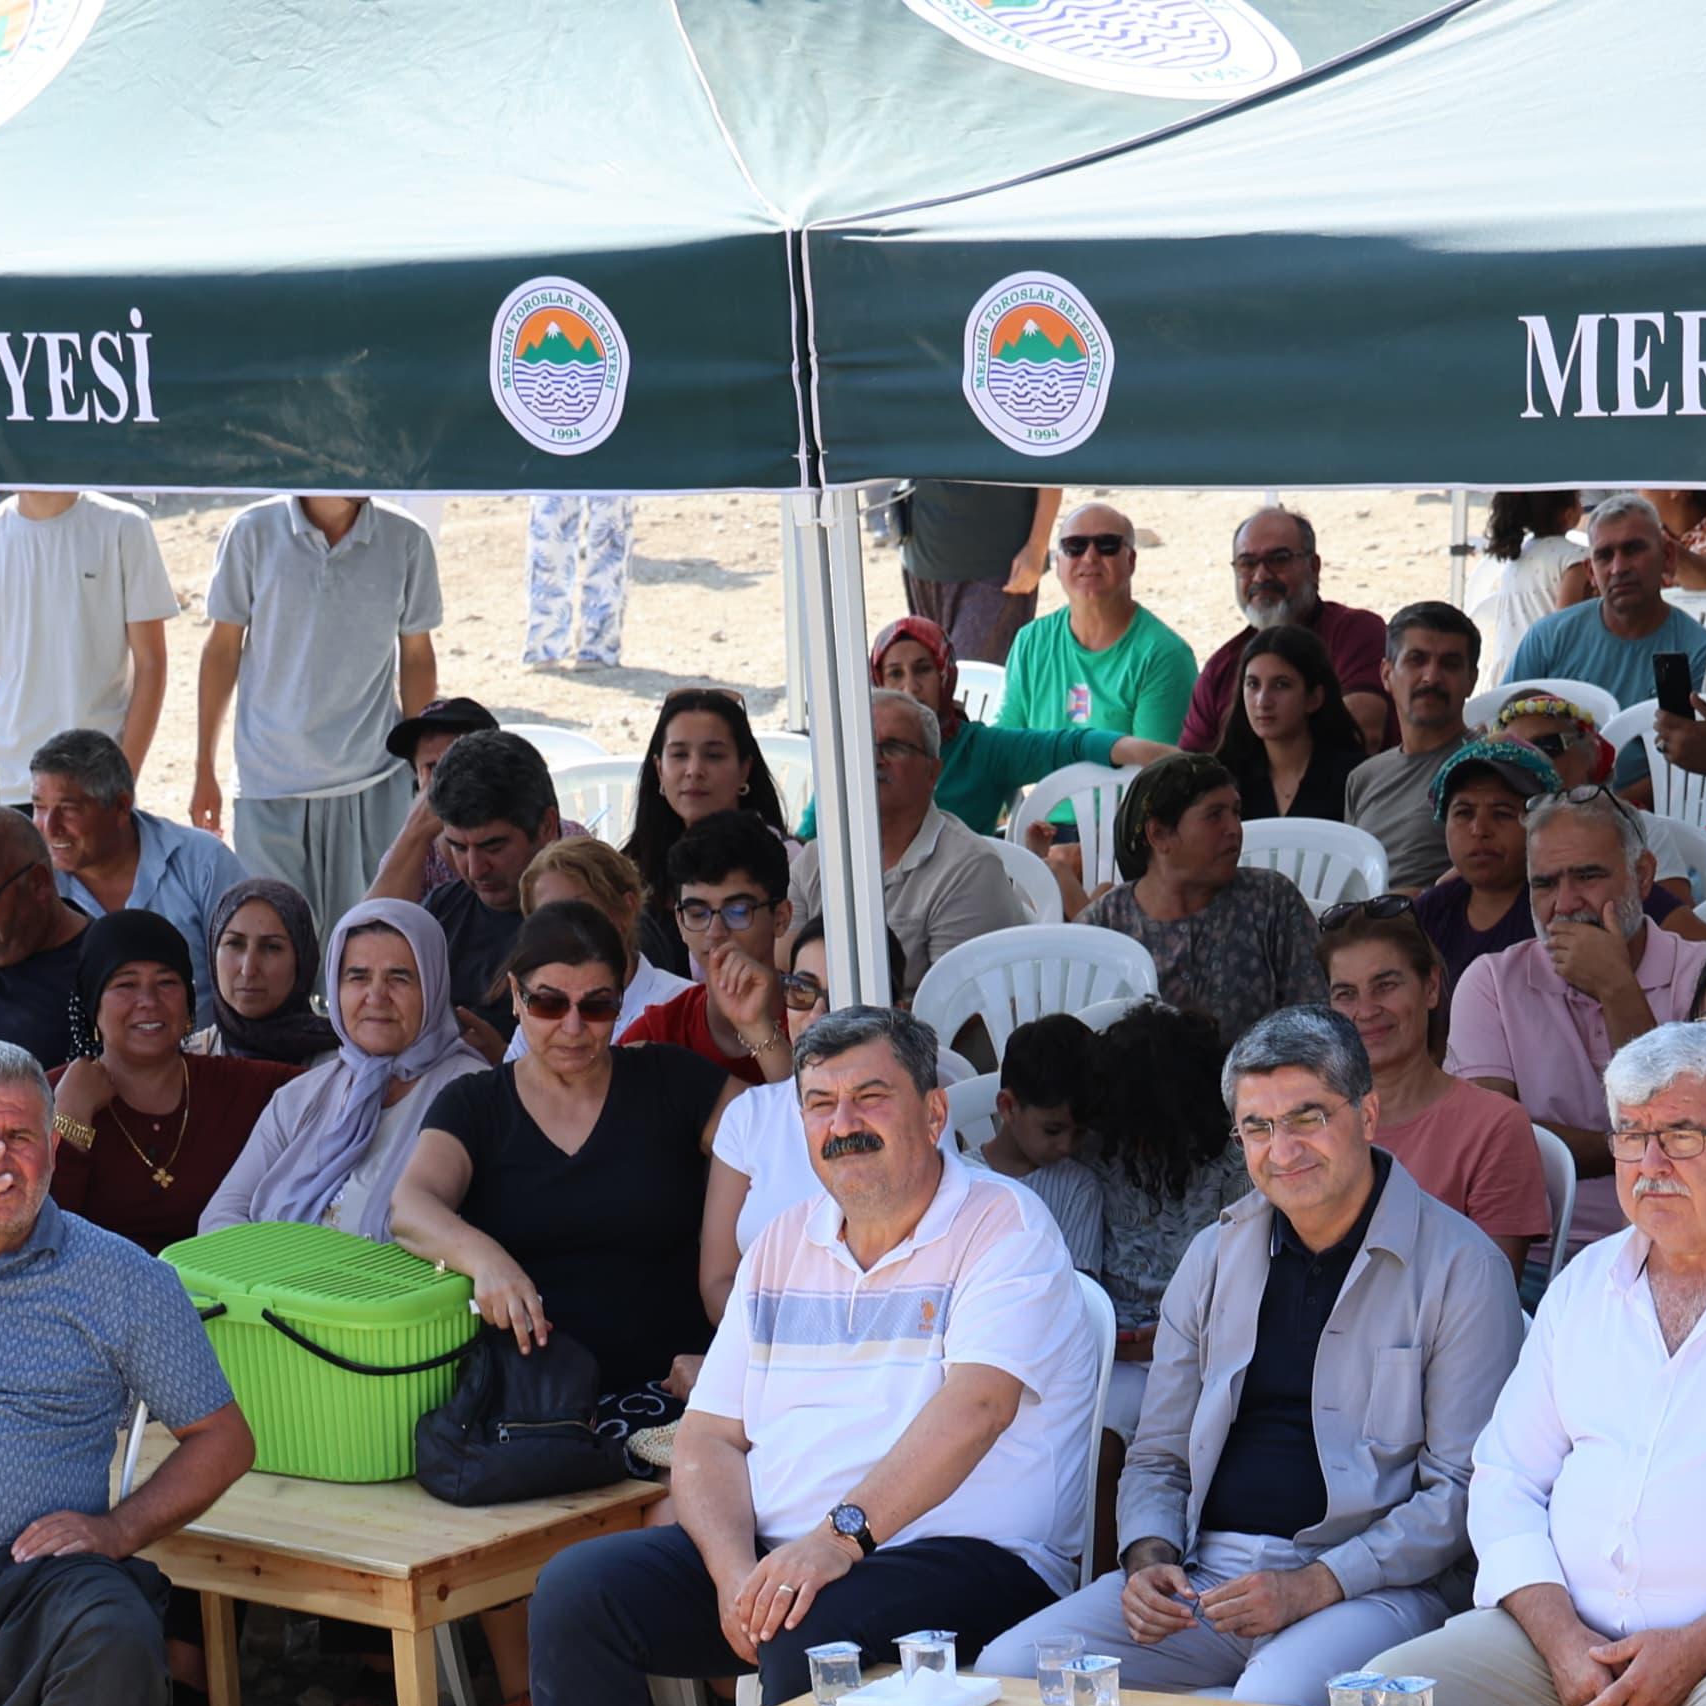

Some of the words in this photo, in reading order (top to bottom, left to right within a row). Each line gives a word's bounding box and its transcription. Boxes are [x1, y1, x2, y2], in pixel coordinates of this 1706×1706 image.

[501, 327, 515, 389] MERSİN
[510, 292, 574, 325] TOROSLAR
[577, 300, 618, 390] BELEDİYESİ
[976, 325, 990, 389] MERSİN
[985, 288, 1055, 323] TOROSLAR
[1057, 296, 1102, 390] BELEDİYESİ
[550, 427, 582, 440] 1994
[1026, 428, 1061, 441] 1994
